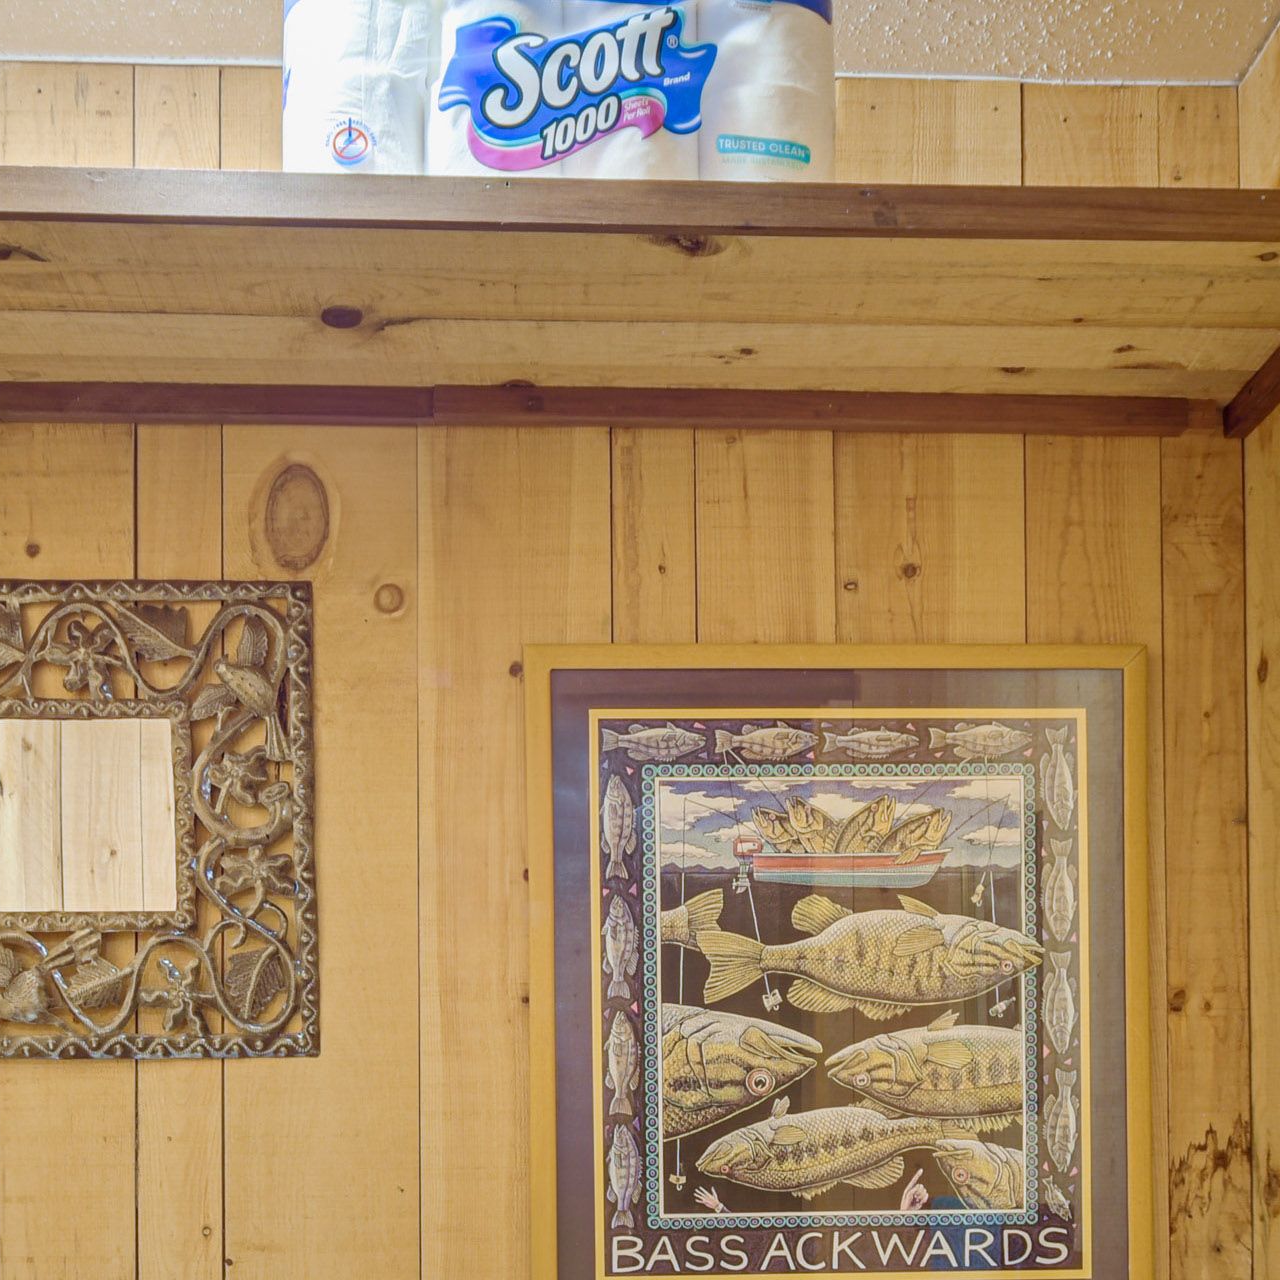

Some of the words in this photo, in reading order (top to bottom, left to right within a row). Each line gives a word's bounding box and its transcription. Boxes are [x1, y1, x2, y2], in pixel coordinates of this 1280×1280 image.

[483, 8, 675, 127] Scott
[663, 71, 691, 87] Brand
[542, 95, 619, 159] 1000
[719, 138, 766, 152] TRUSTED
[769, 143, 806, 158] CLEAN
[611, 1234, 749, 1274] BASS
[760, 1227, 1070, 1271] ACKWARDS
